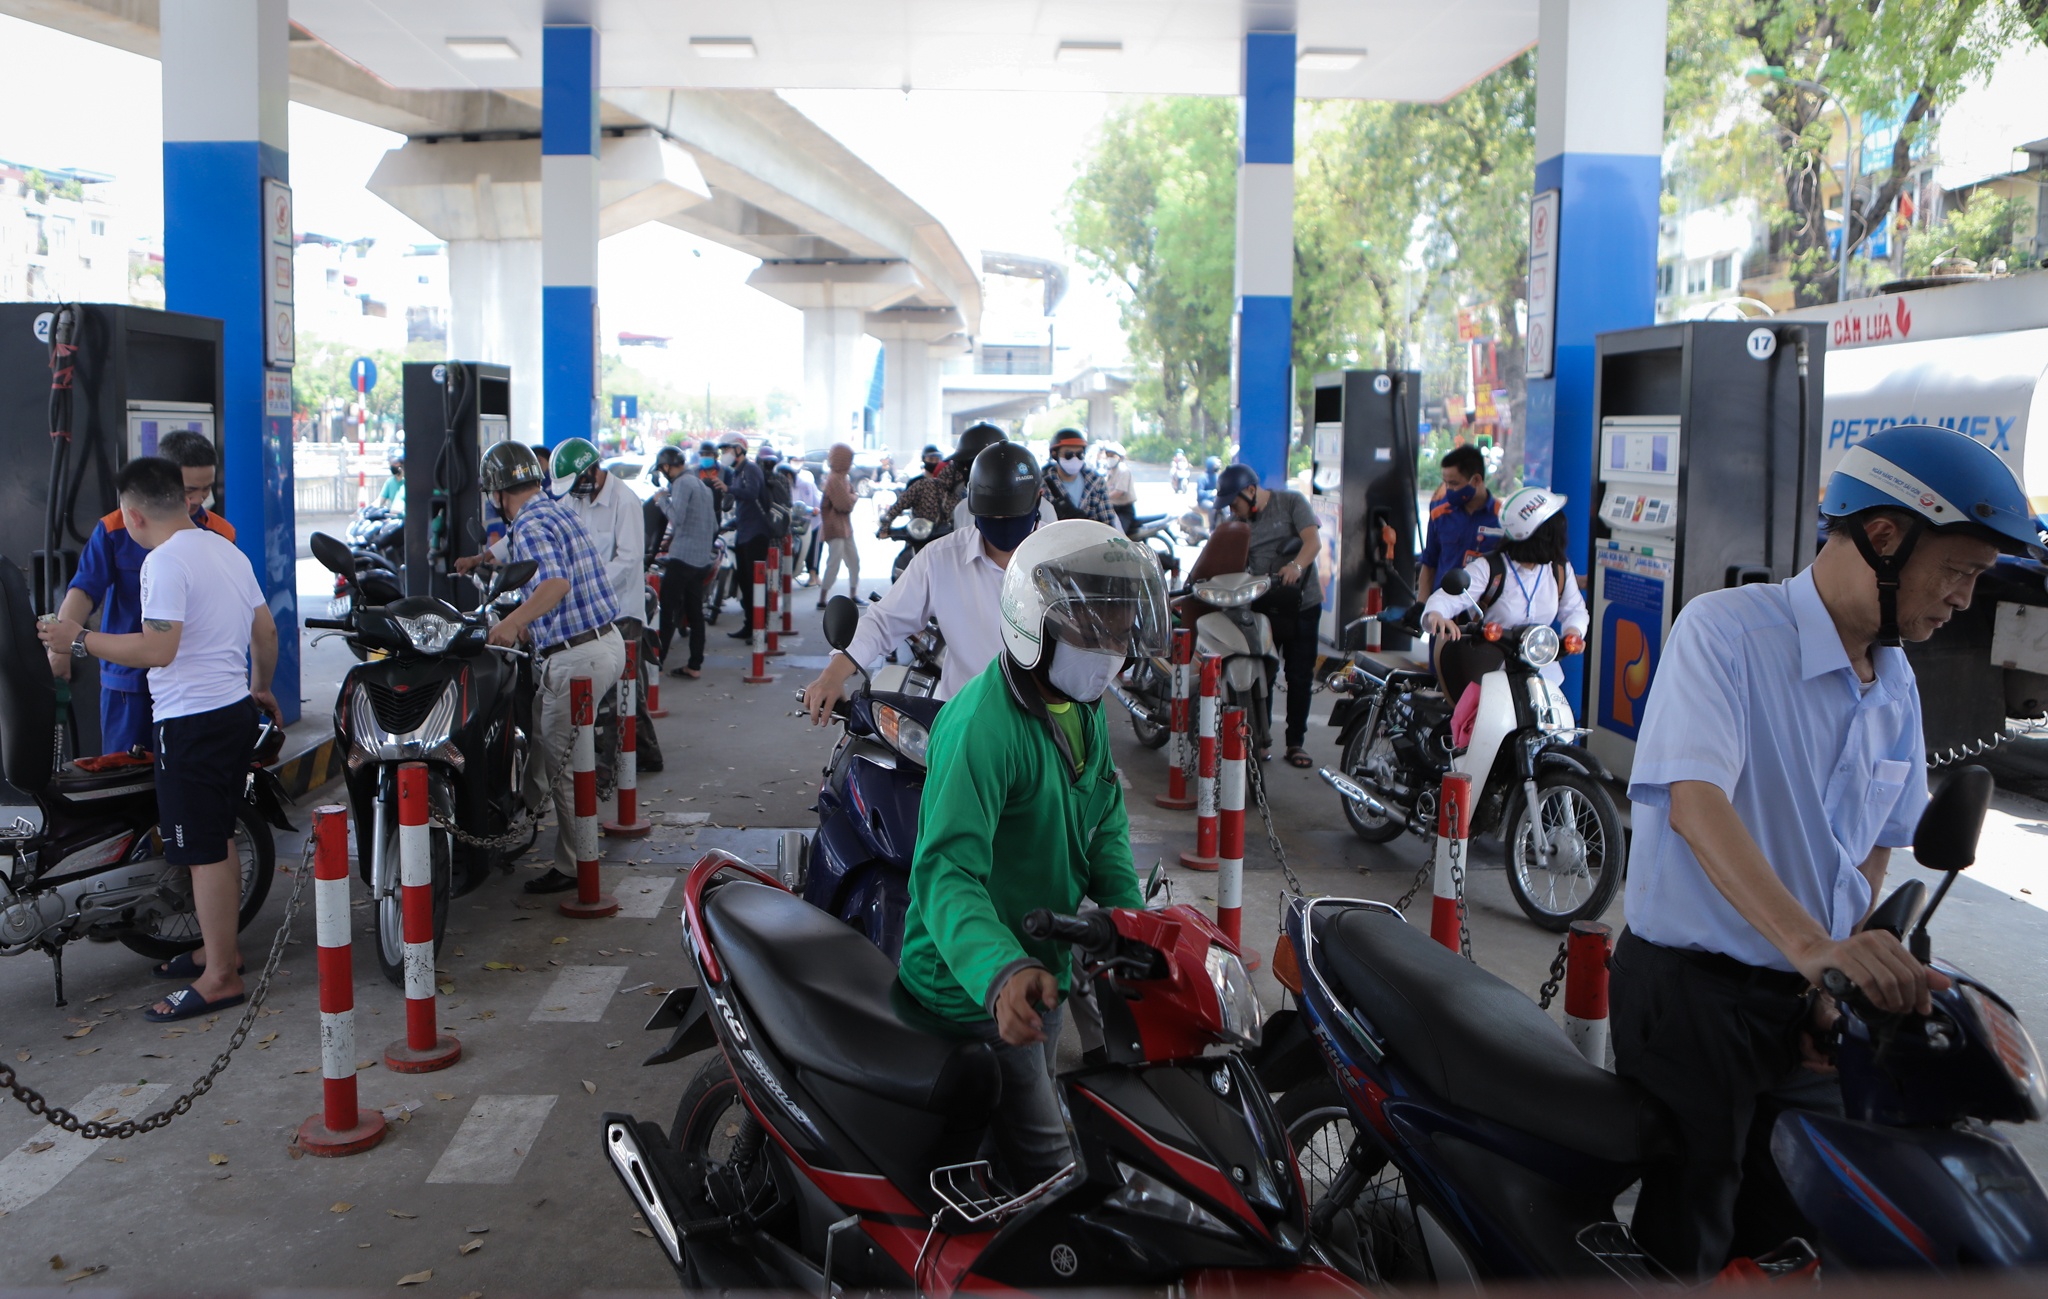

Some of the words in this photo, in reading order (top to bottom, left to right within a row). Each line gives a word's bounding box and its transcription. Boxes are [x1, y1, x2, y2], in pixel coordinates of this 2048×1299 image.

[1752, 336, 1772, 350] 17
[1377, 378, 1389, 388] 19
[1828, 415, 2017, 452] PETMEX
[574, 451, 592, 468] Grab
[1518, 494, 1548, 521] ITALIA
[1312, 1022, 1360, 1089] Future
